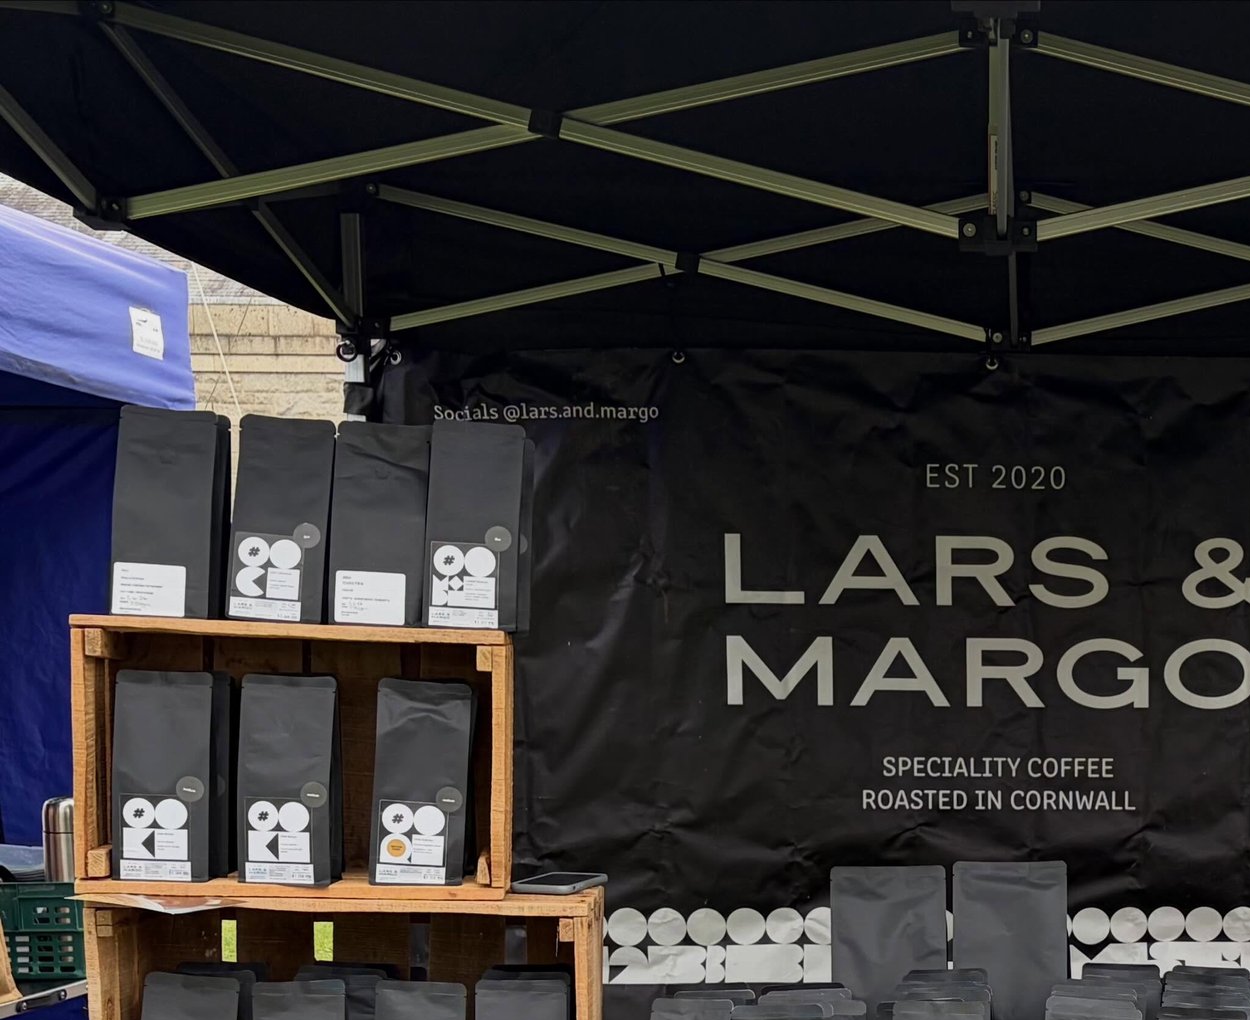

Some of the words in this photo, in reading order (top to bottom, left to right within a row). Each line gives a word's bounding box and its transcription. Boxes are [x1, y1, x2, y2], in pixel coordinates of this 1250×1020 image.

[434, 404, 499, 421] Socials
[503, 402, 659, 423] @lars.and.margo
[926, 463, 979, 489] EST
[991, 465, 1067, 490] 2020
[724, 532, 1110, 609] LARS
[882, 756, 1021, 779] SPECIALITY
[1027, 757, 1115, 779] COFFEE
[861, 790, 968, 811] ROASTED
[974, 790, 1002, 811] IN
[1009, 790, 1137, 812] CORNWALL
